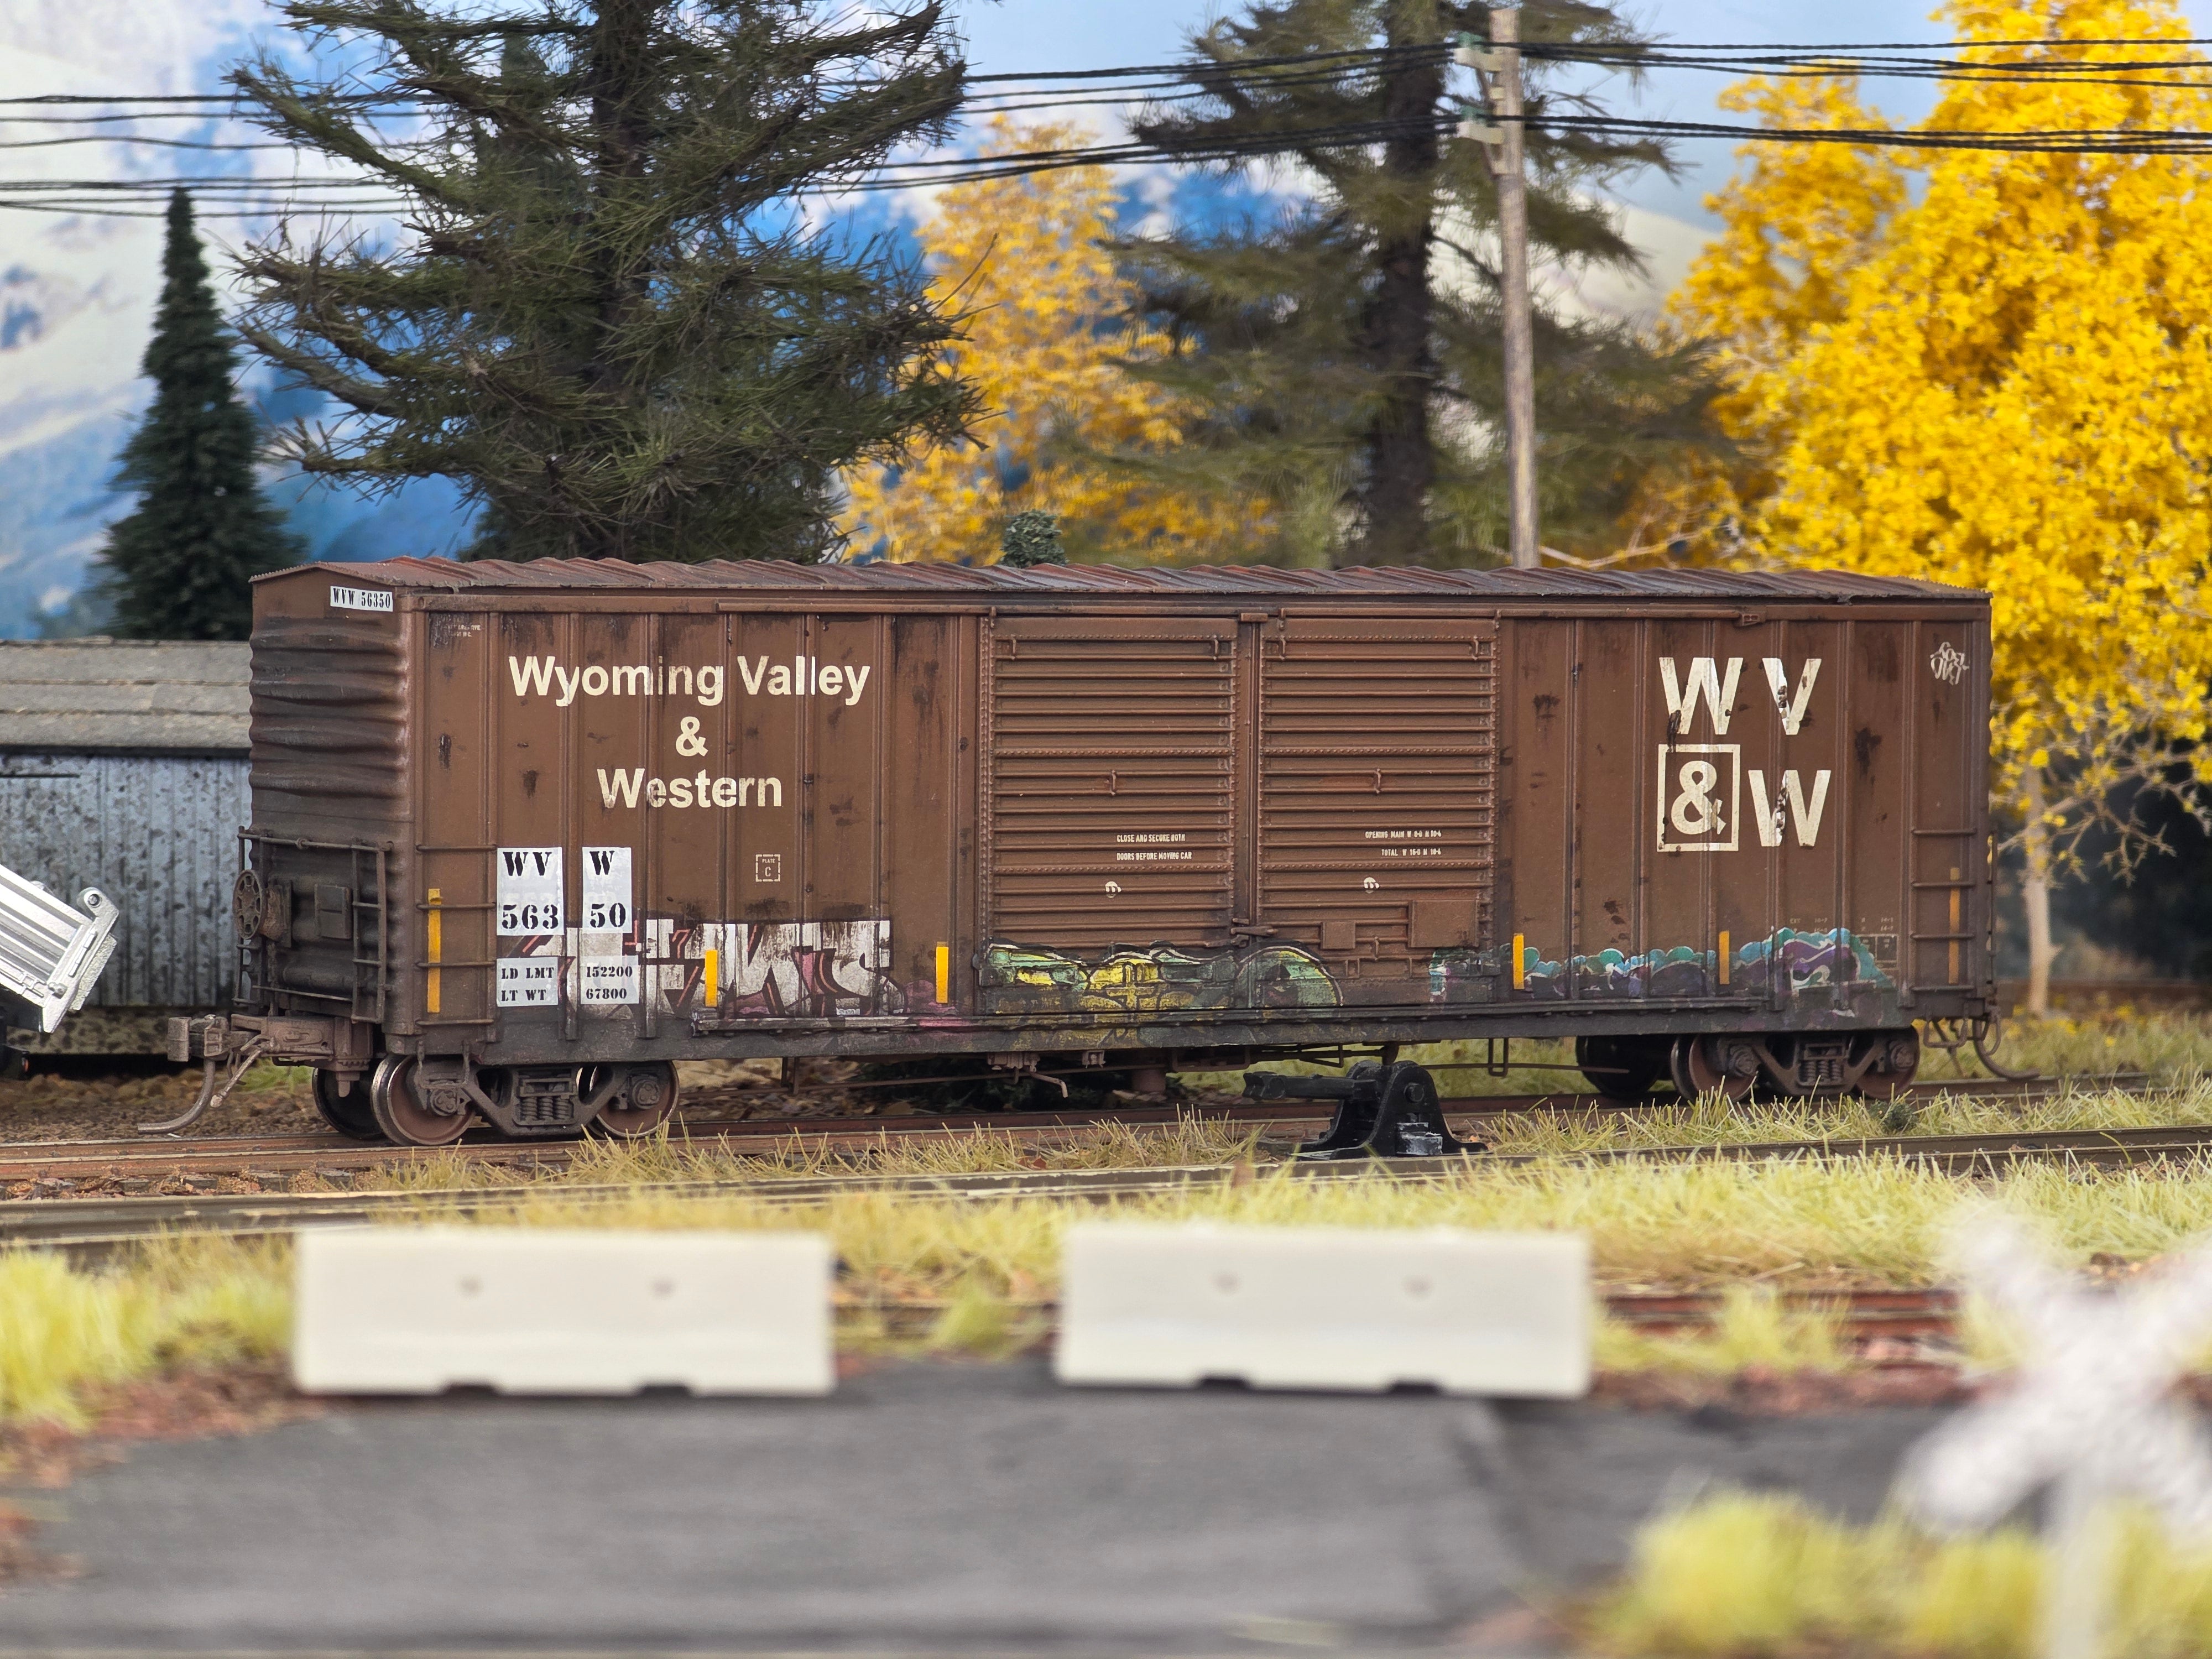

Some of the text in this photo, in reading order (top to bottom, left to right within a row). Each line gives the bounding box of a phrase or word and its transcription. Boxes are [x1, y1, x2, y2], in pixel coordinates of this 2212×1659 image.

[333, 588, 390, 608] WVW 56350
[508, 655, 870, 707] Wyoming Valley
[675, 716, 708, 757] &
[597, 768, 782, 808] Western
[1671, 760, 1831, 847] & W
[1135, 834, 1147, 842] AND
[1148, 834, 1170, 842] SECURE
[589, 851, 615, 875] W
[1117, 852, 1135, 860] DOORS
[1136, 852, 1157, 860] BEFORE
[765, 867, 771, 877] C
[502, 902, 626, 930] 563 50
[501, 968, 554, 979] LD LMT
[586, 966, 633, 977] 152200
[501, 989, 546, 1001] LT WT
[586, 988, 627, 999] 67800
